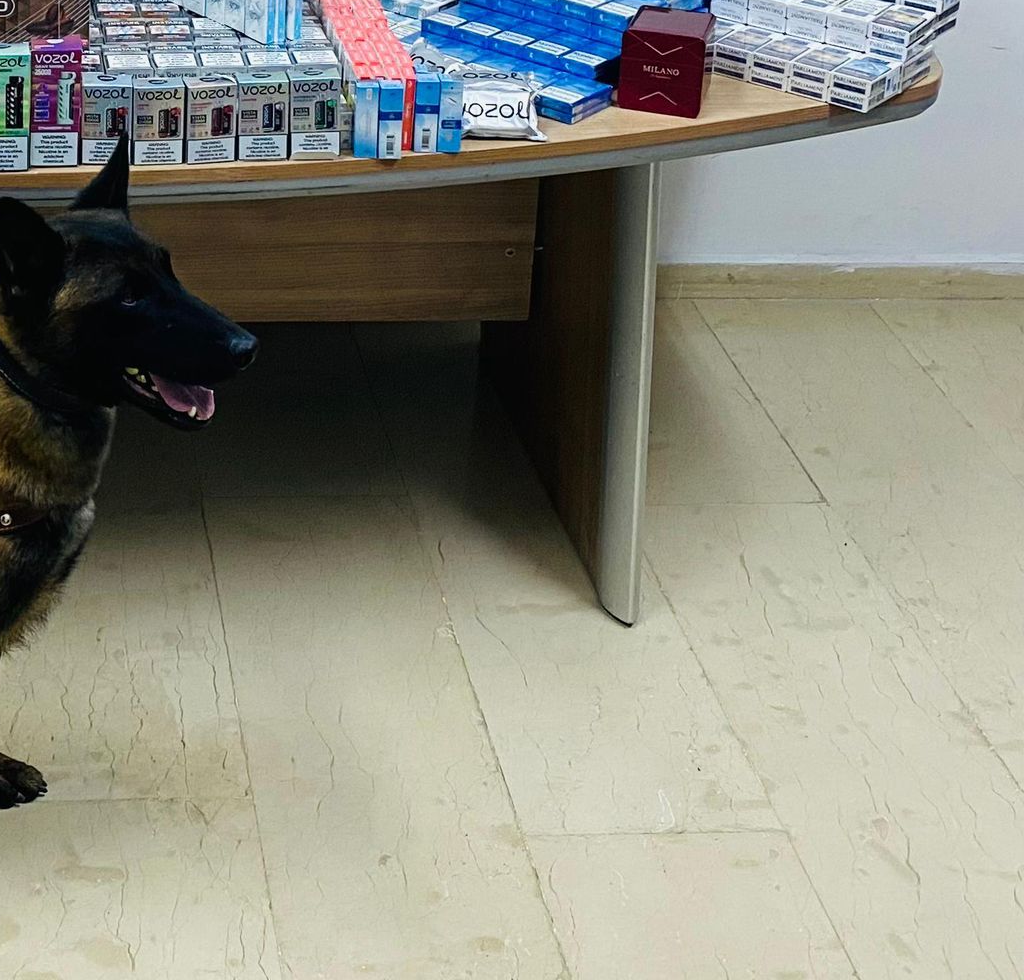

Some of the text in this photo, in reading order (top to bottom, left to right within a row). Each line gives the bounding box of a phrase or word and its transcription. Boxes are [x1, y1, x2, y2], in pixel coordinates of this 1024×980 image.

[872, 25, 906, 36] PARLIAMENT
[34, 51, 79, 64] VOZOL
[754, 55, 786, 66] PARLIAMENT
[643, 64, 680, 77] MILANO
[751, 70, 783, 82] PARLIAMENT
[792, 64, 825, 76] PARLIAMENT
[292, 79, 338, 93] VOZOL
[790, 80, 824, 92] PARLIAMENT
[833, 75, 867, 87] PARLIAMENT
[84, 88, 130, 100] VOZOL
[137, 88, 182, 101] VOZOL
[190, 86, 235, 100] VOZOL
[241, 83, 286, 96] VOZOL
[830, 90, 864, 103] PARLIAMENT
